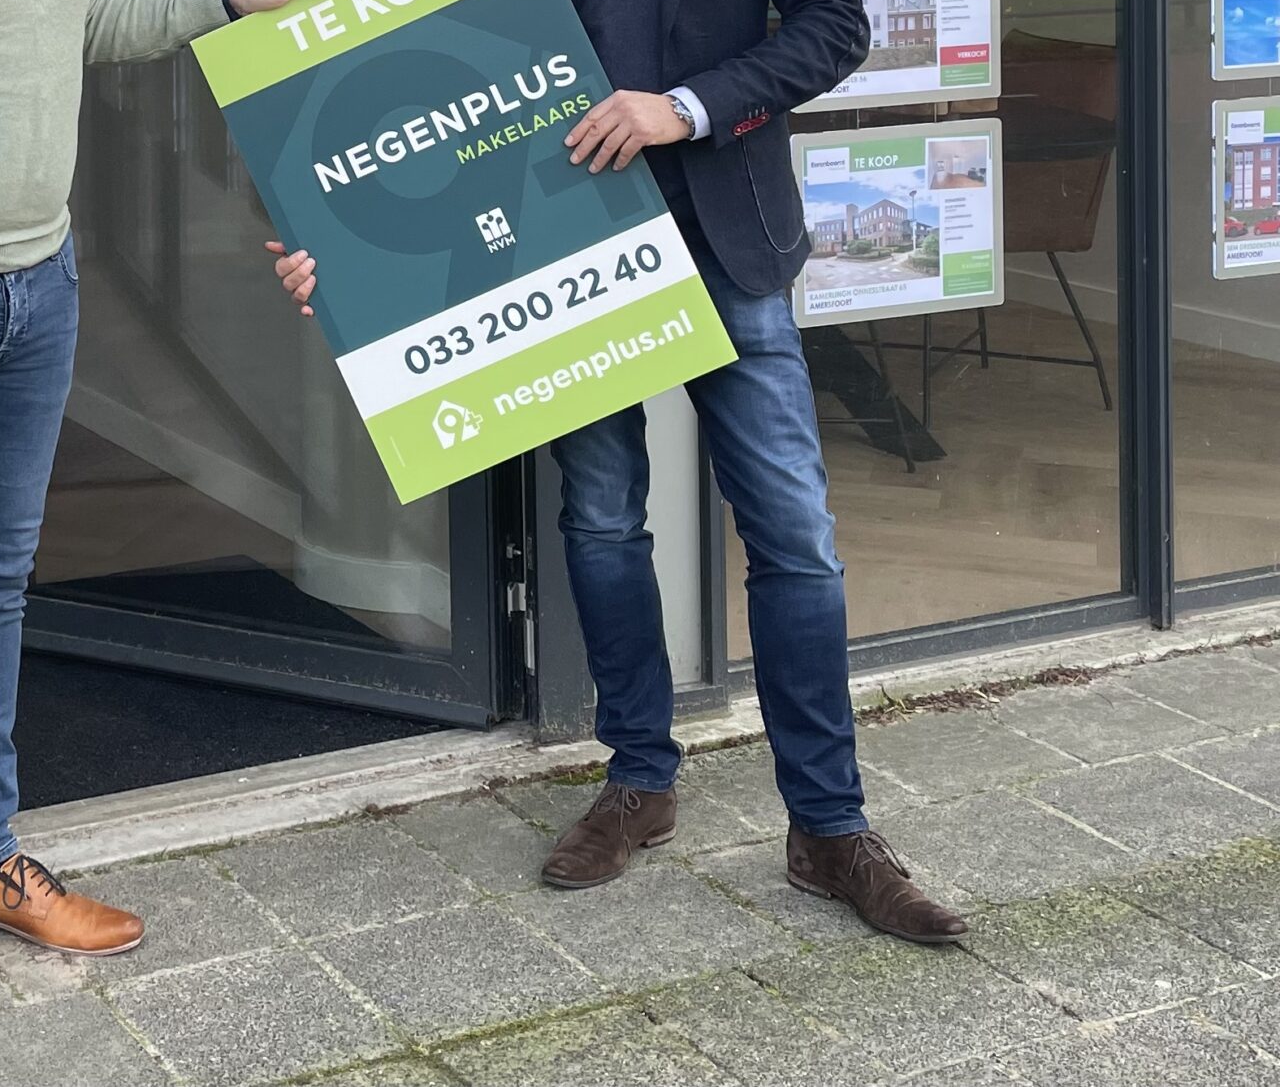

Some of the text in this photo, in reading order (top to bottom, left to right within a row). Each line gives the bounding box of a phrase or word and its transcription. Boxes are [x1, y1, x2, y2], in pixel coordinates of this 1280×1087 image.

[276, 0, 347, 52] TE
[313, 54, 578, 194] NEGENPLUS
[455, 93, 593, 165] MAKELAARS
[854, 154, 899, 169] TE KOOP
[486, 233, 517, 254] NVM
[404, 242, 663, 374] 033 200 22 40
[809, 298, 853, 310] AMERSFOORT
[492, 309, 695, 416] negenplus.nl
